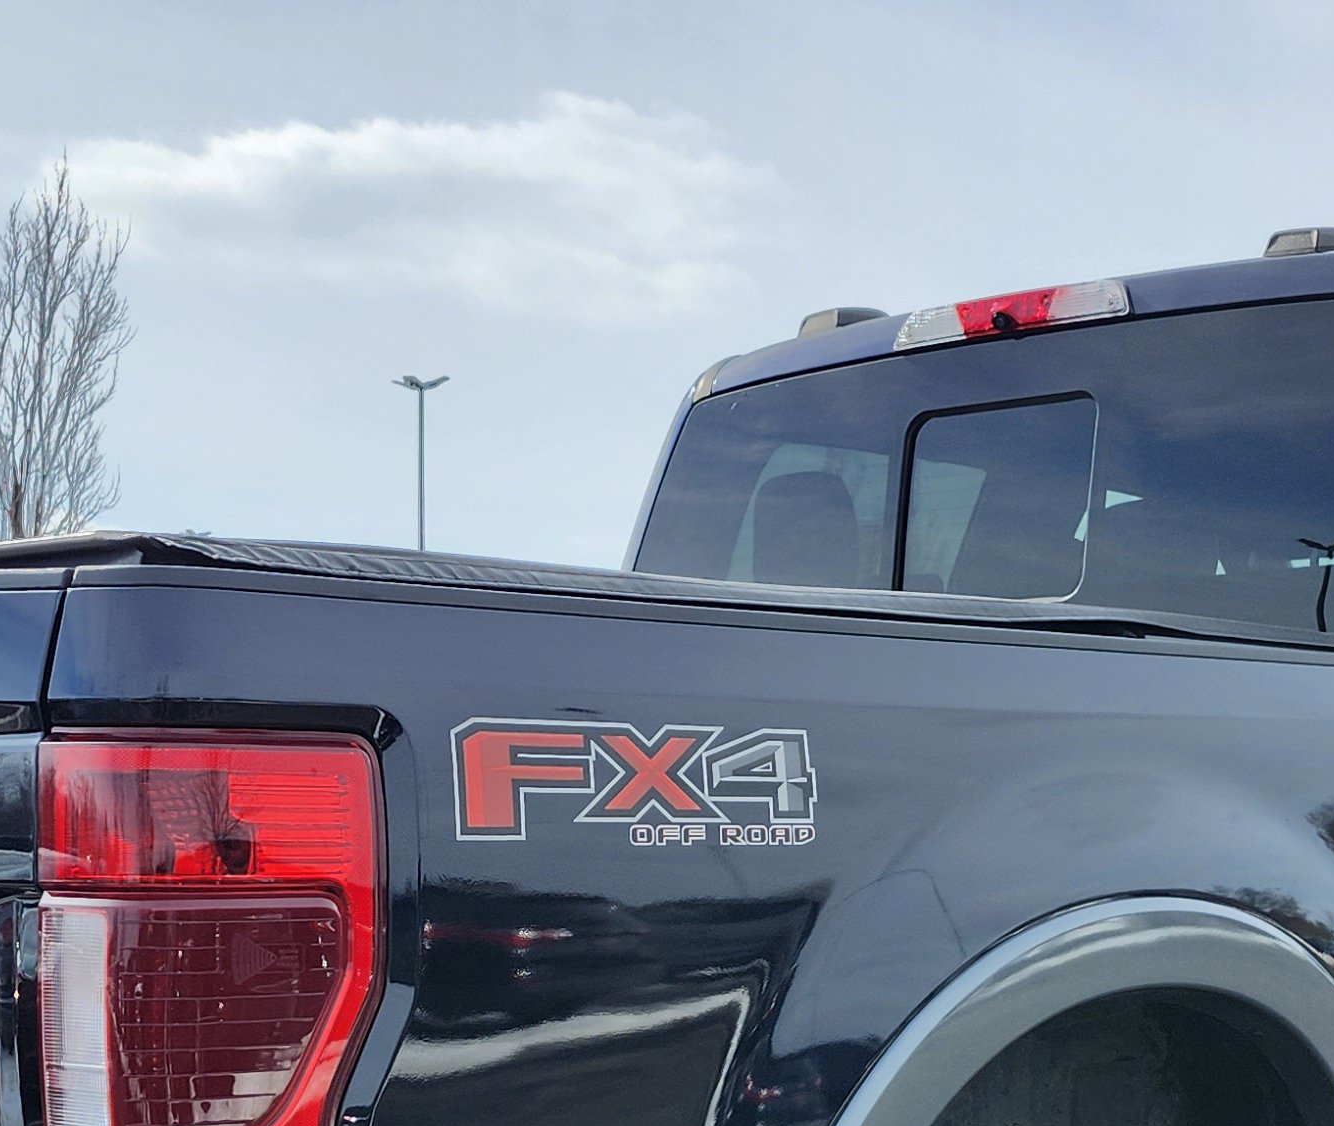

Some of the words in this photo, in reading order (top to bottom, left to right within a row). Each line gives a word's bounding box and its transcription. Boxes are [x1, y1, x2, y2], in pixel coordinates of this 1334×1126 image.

[450, 717, 818, 841] FX4
[629, 824, 706, 846] OFF
[719, 824, 816, 846] ROAD
